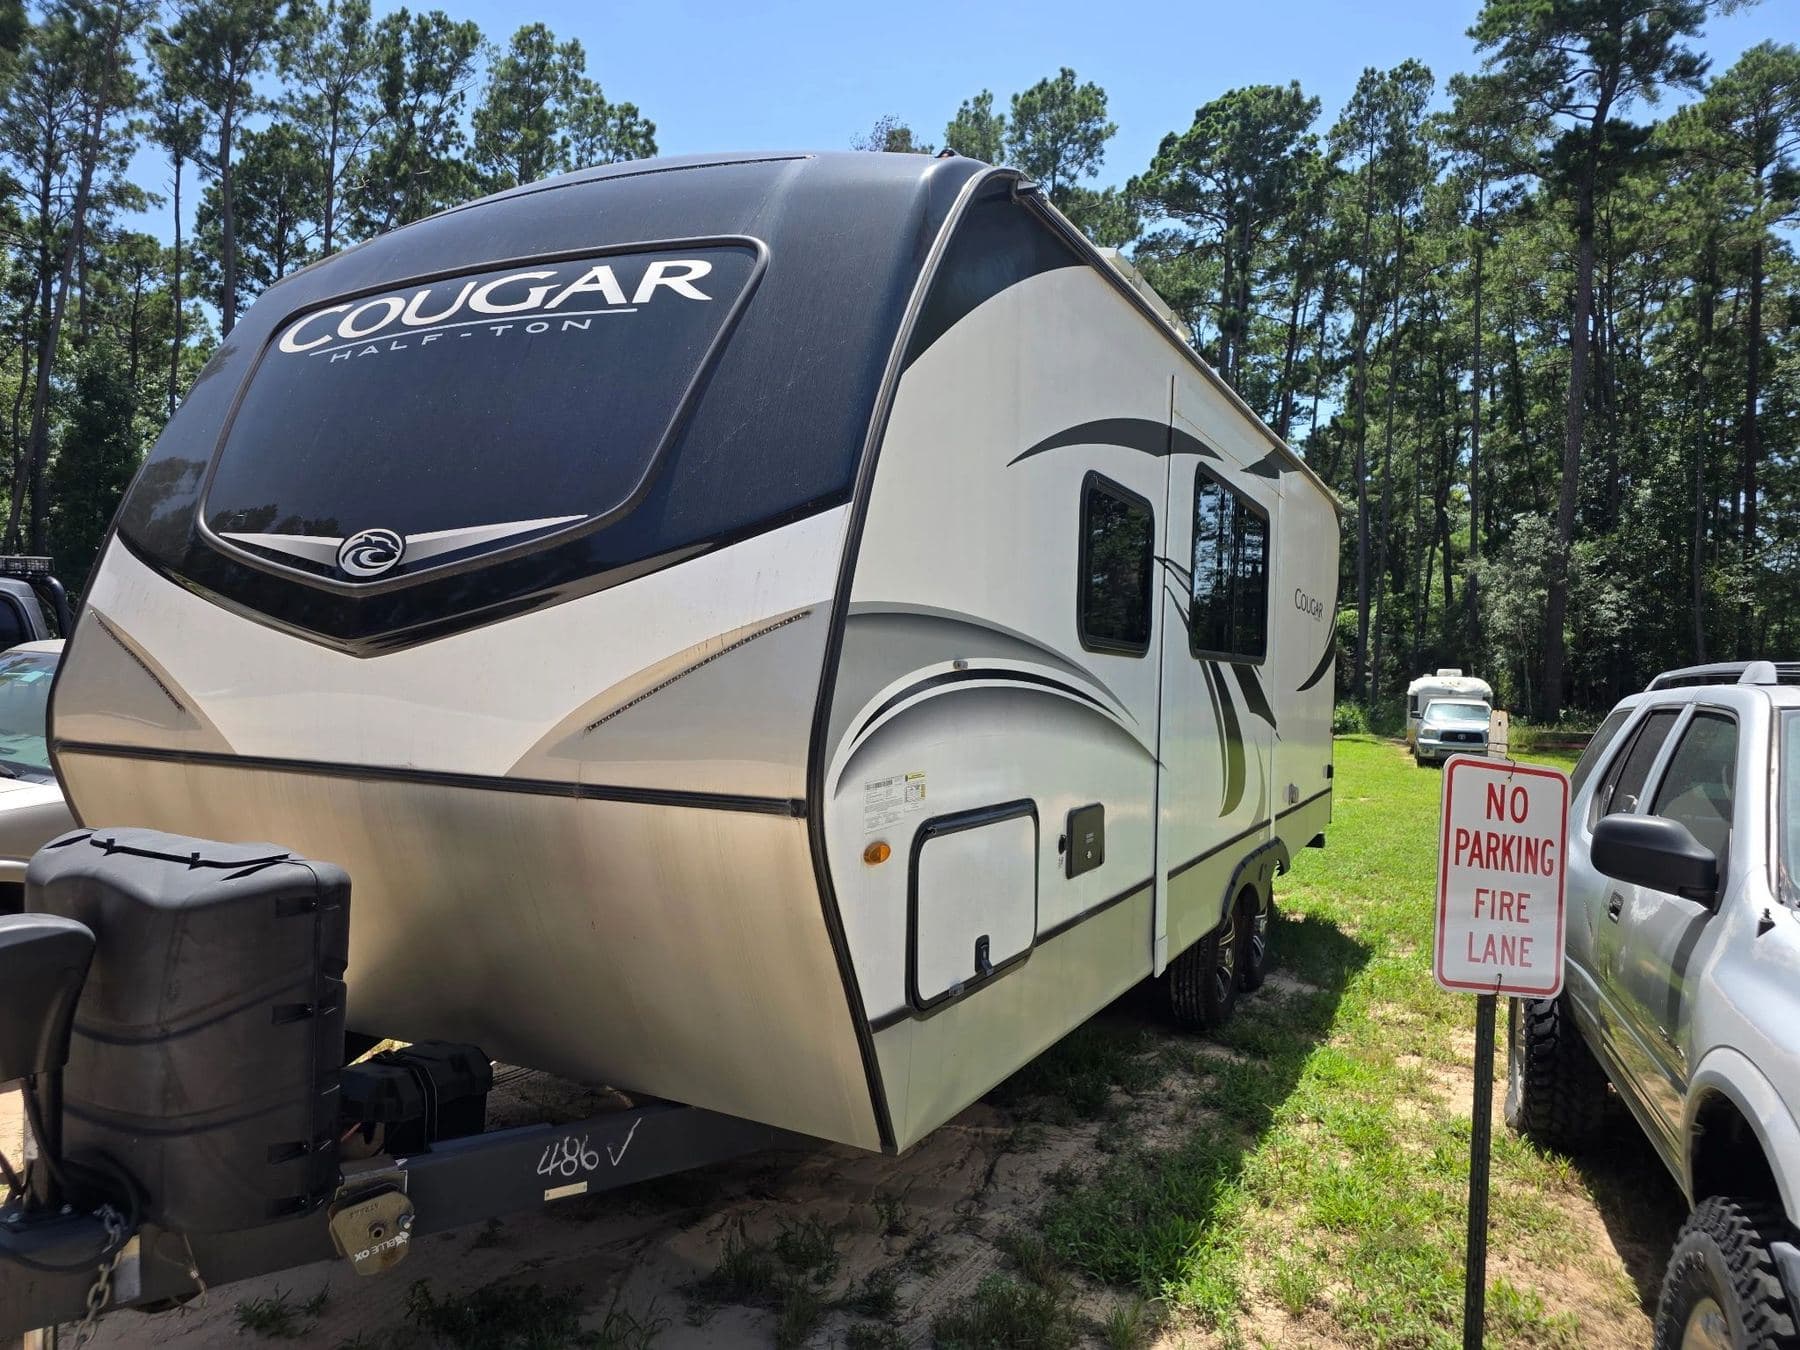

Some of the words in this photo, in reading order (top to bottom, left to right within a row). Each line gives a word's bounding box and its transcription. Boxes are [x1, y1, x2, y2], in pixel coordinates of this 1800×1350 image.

[278, 259, 713, 353] COUGAR
[1294, 588, 1323, 618] COUGAR
[1486, 782, 1529, 824] NO
[1454, 828, 1555, 877] PARKING
[1474, 887, 1532, 924] FIRE
[1467, 931, 1534, 968] LANE
[536, 1133, 600, 1177] 486
[354, 1249, 370, 1262] OX
